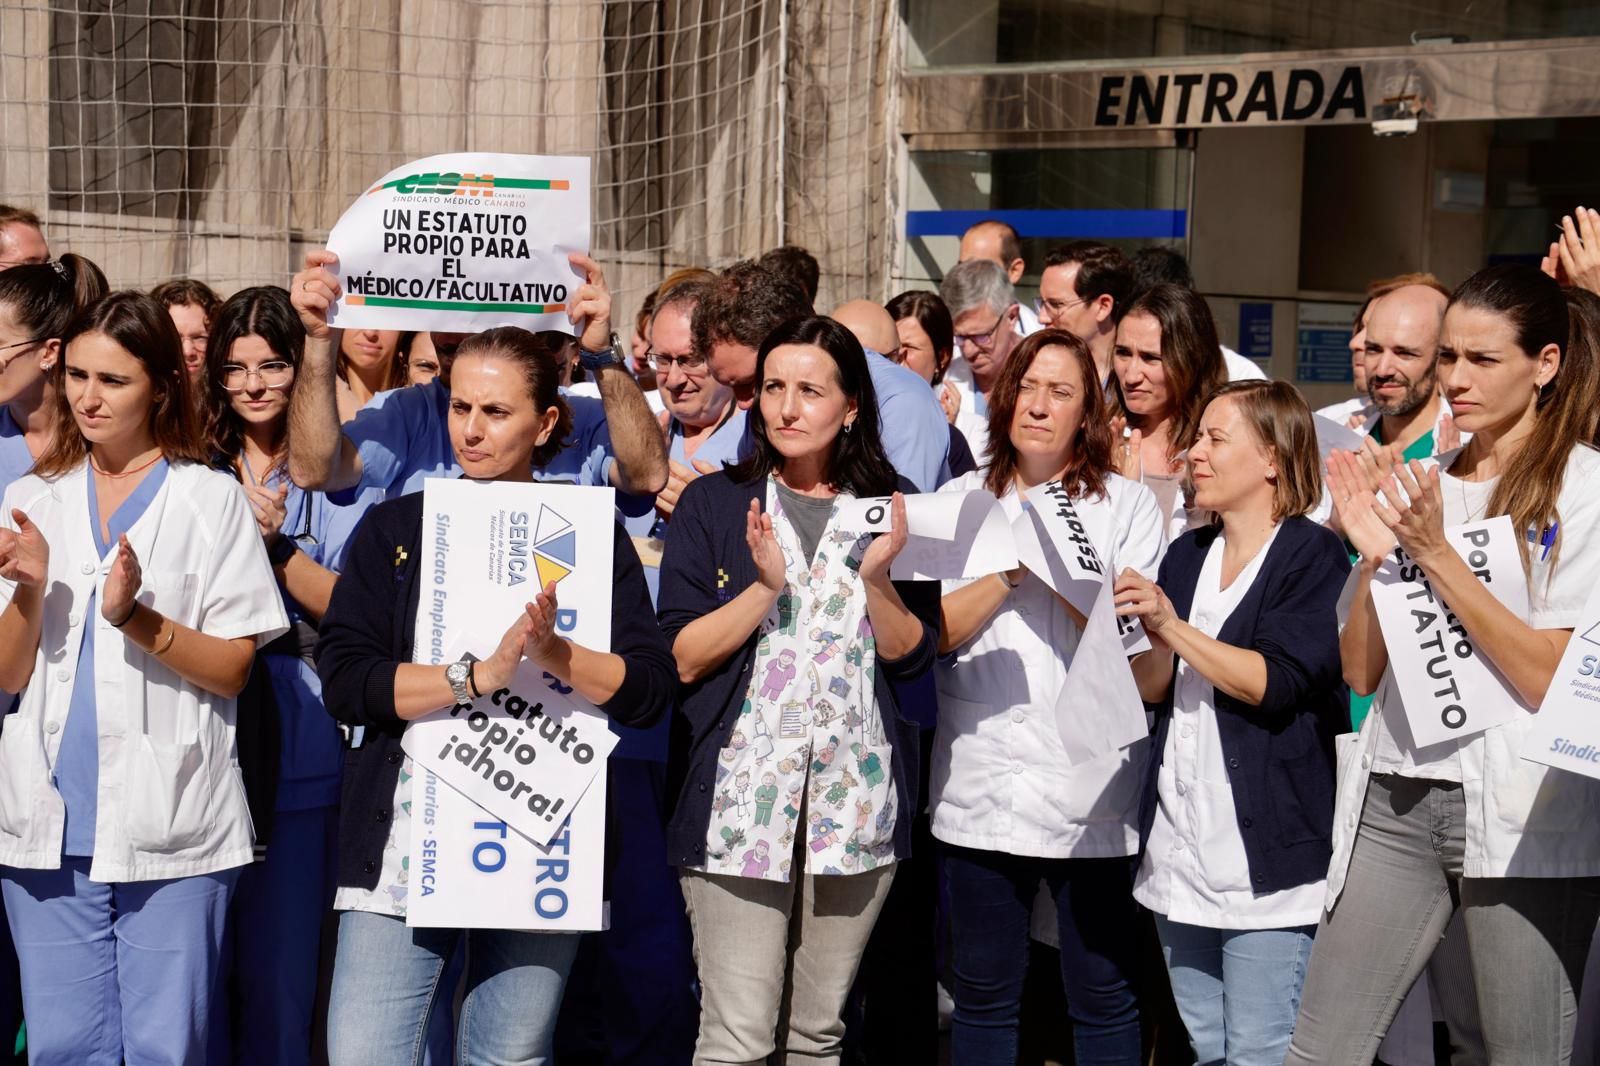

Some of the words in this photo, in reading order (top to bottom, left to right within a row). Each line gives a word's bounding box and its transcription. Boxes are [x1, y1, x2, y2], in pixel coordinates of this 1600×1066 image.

[1094, 66, 1367, 126] ENTRADA
[396, 172, 495, 198] CESM
[391, 195, 441, 204] SINDICATO
[443, 195, 481, 206] MÉDICO
[483, 199, 527, 208] CANARIO
[383, 209, 411, 231] UN
[417, 210, 527, 236] ESTATUTO
[383, 232, 464, 256] PROPIO
[471, 237, 530, 259] PARA
[442, 258, 466, 279] EL
[347, 270, 568, 303] MÉDICO/FACULTATIVO
[490, 515, 498, 541] Médicos
[498, 509, 506, 539] Sindicato
[1044, 480, 1102, 576] Estatut
[434, 513, 450, 585] Sindicato
[489, 542, 496, 551] de
[498, 540, 505, 549] de
[507, 511, 529, 587] SEMCA
[1462, 528, 1492, 584] Por
[488, 552, 496, 581] Canarias
[496, 549, 504, 585] Empleados
[450, 702, 536, 765] ropio
[438, 735, 565, 822] ¡ahora!
[421, 839, 437, 896] SEMCA
